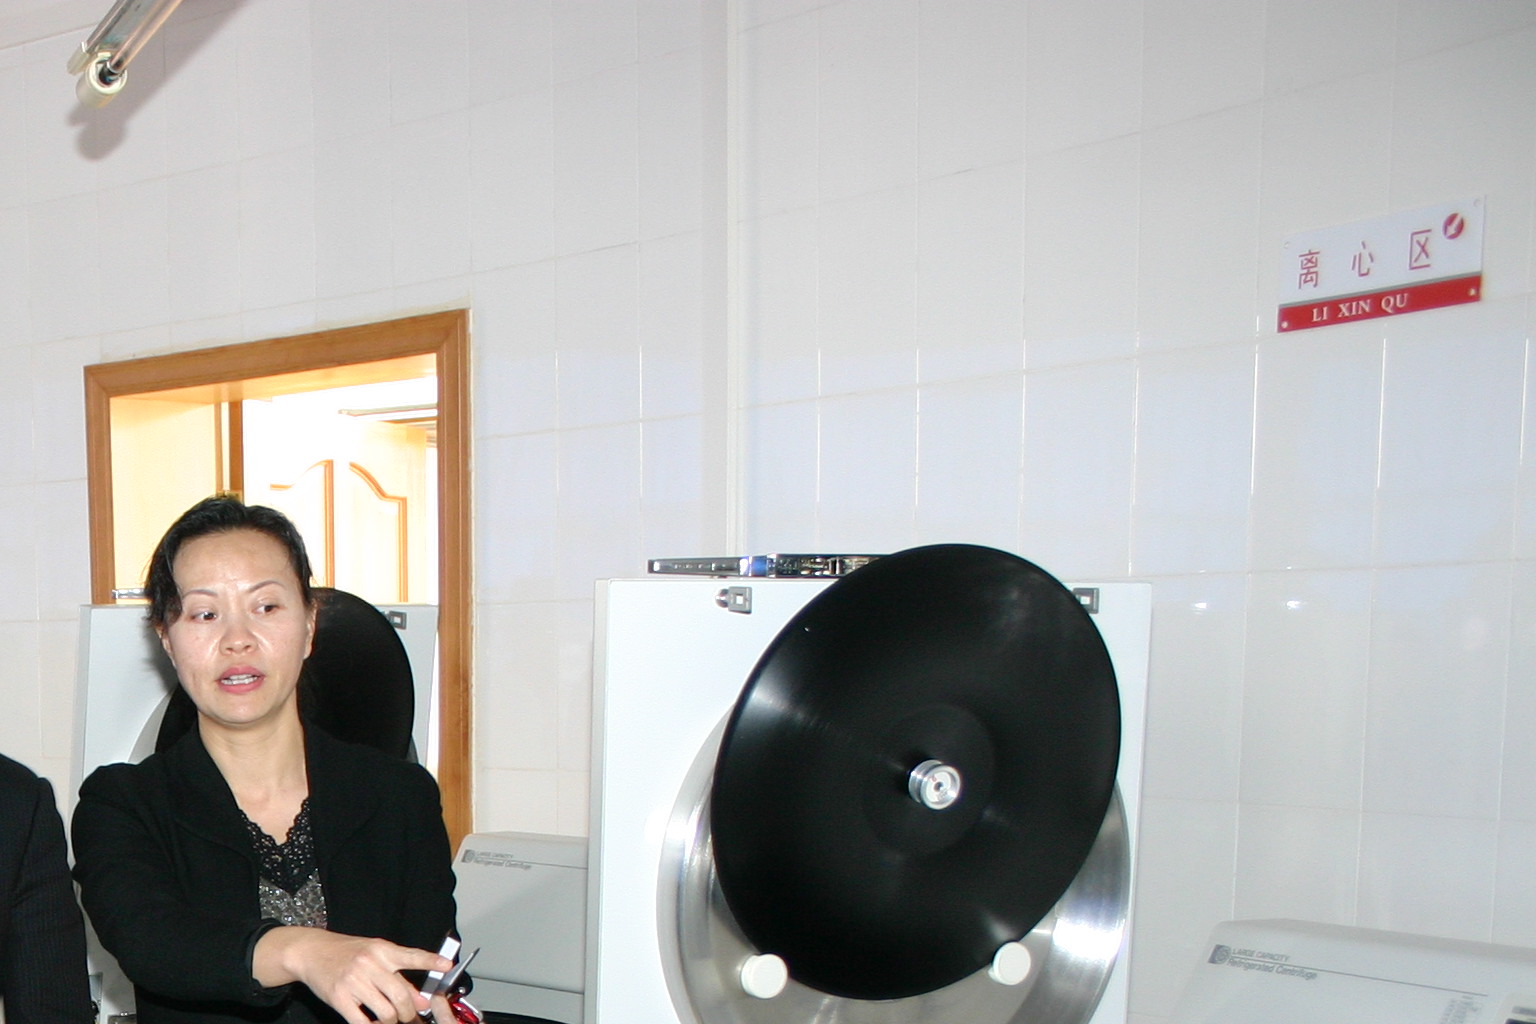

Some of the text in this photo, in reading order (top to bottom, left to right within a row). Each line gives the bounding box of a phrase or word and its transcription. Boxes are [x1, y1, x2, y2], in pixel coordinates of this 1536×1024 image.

[1298, 228, 1433, 290] 离心区
[1311, 293, 1409, 323] LI XIN QU
